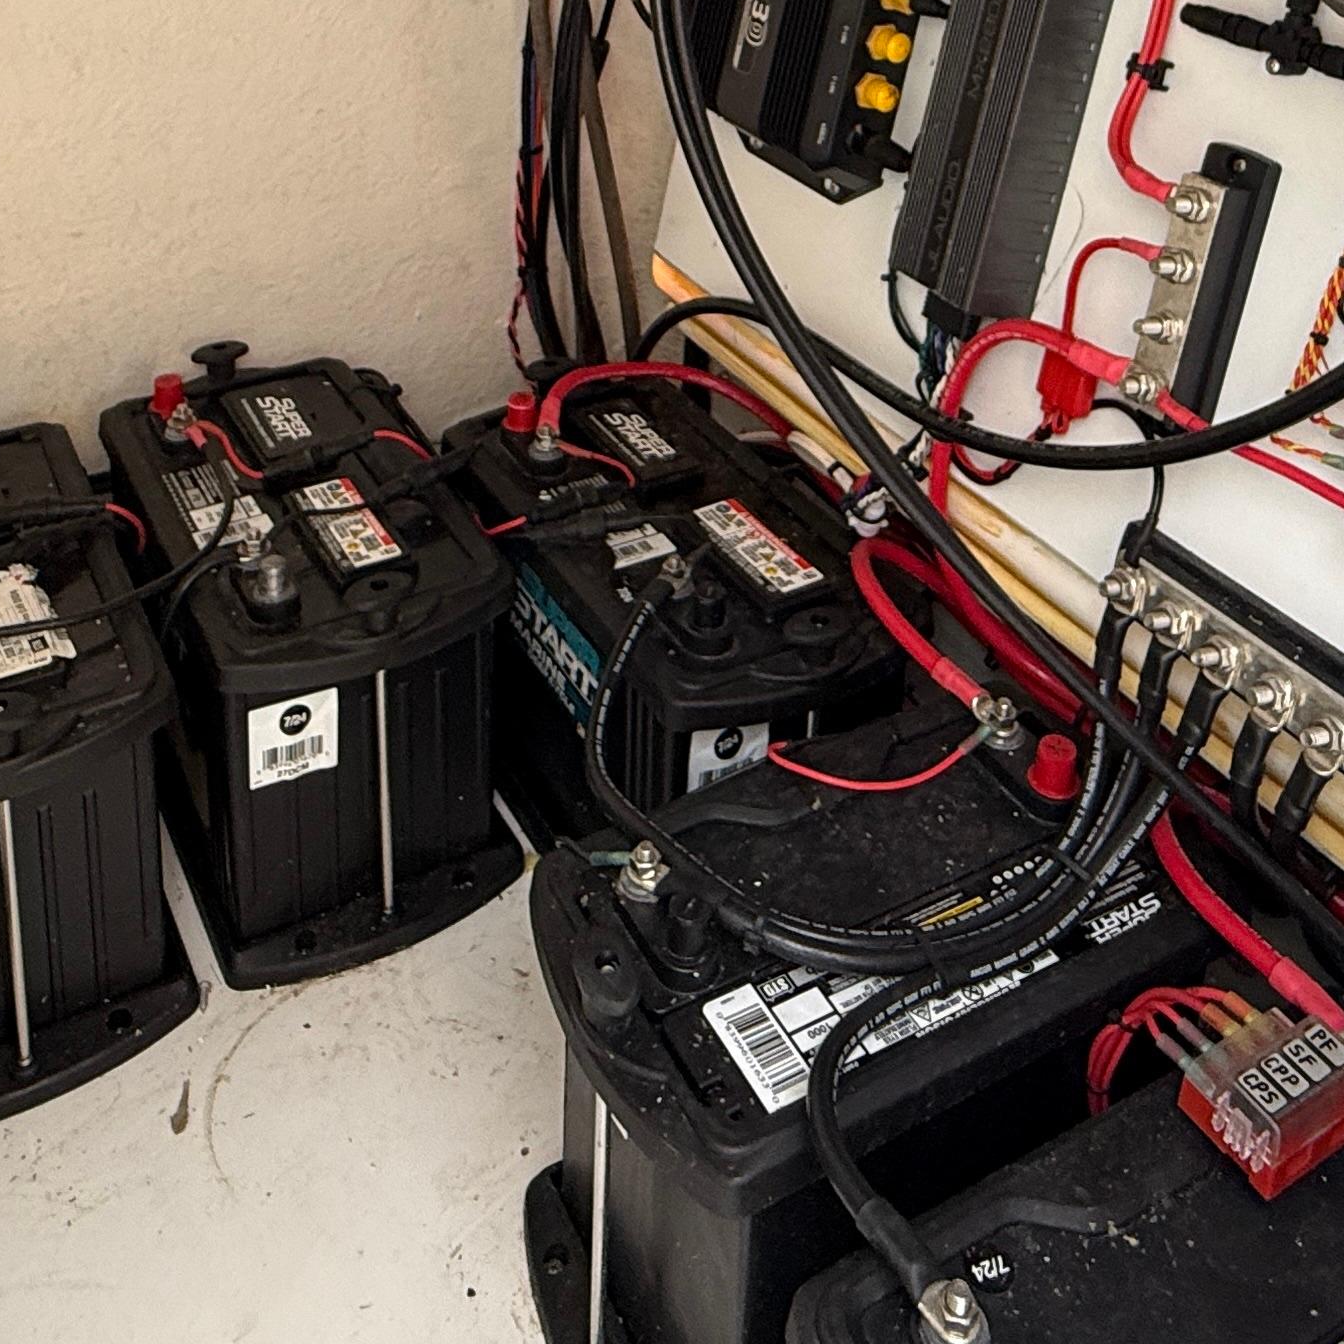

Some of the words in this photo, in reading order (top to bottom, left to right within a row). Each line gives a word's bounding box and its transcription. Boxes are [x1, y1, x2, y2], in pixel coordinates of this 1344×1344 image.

[256, 396, 298, 441] START
[278, 398, 312, 437] SUPER
[603, 413, 664, 459] START
[623, 413, 676, 456] SUPER
[514, 576, 599, 698] START
[1090, 892, 1161, 938] START
[762, 978, 789, 996] STD
[807, 1022, 832, 1039] 1000
[1311, 1029, 1337, 1051] PF
[1288, 1044, 1317, 1065] SF
[1264, 1057, 1299, 1085] CPP
[1243, 1074, 1279, 1104] CPS
[971, 1254, 1011, 1283] 7/24
